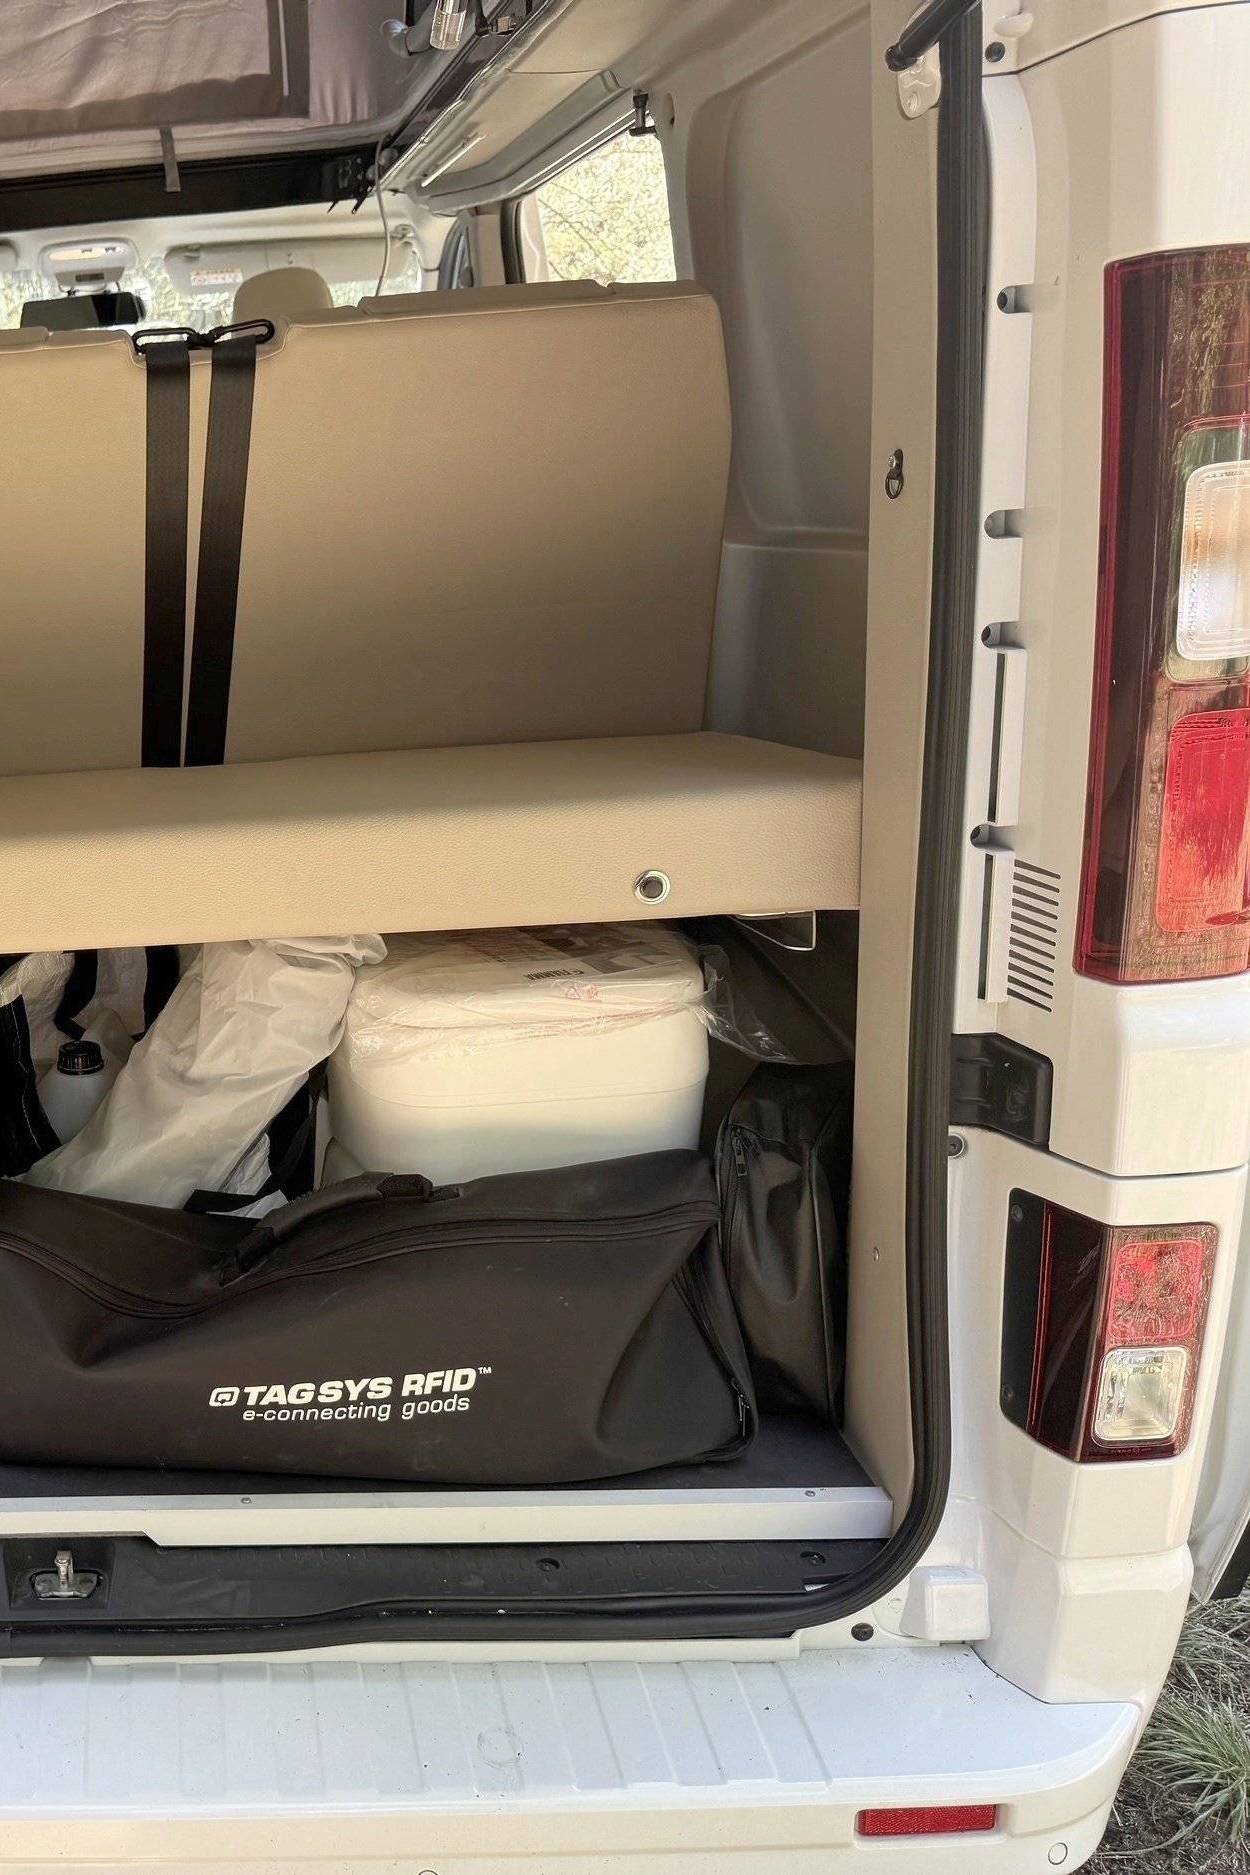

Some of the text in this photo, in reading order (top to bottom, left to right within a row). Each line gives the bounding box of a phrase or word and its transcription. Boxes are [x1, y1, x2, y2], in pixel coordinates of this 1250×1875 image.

[243, 1376, 393, 1406] TAGSYS
[242, 1393, 471, 1422] e-connecting goods
